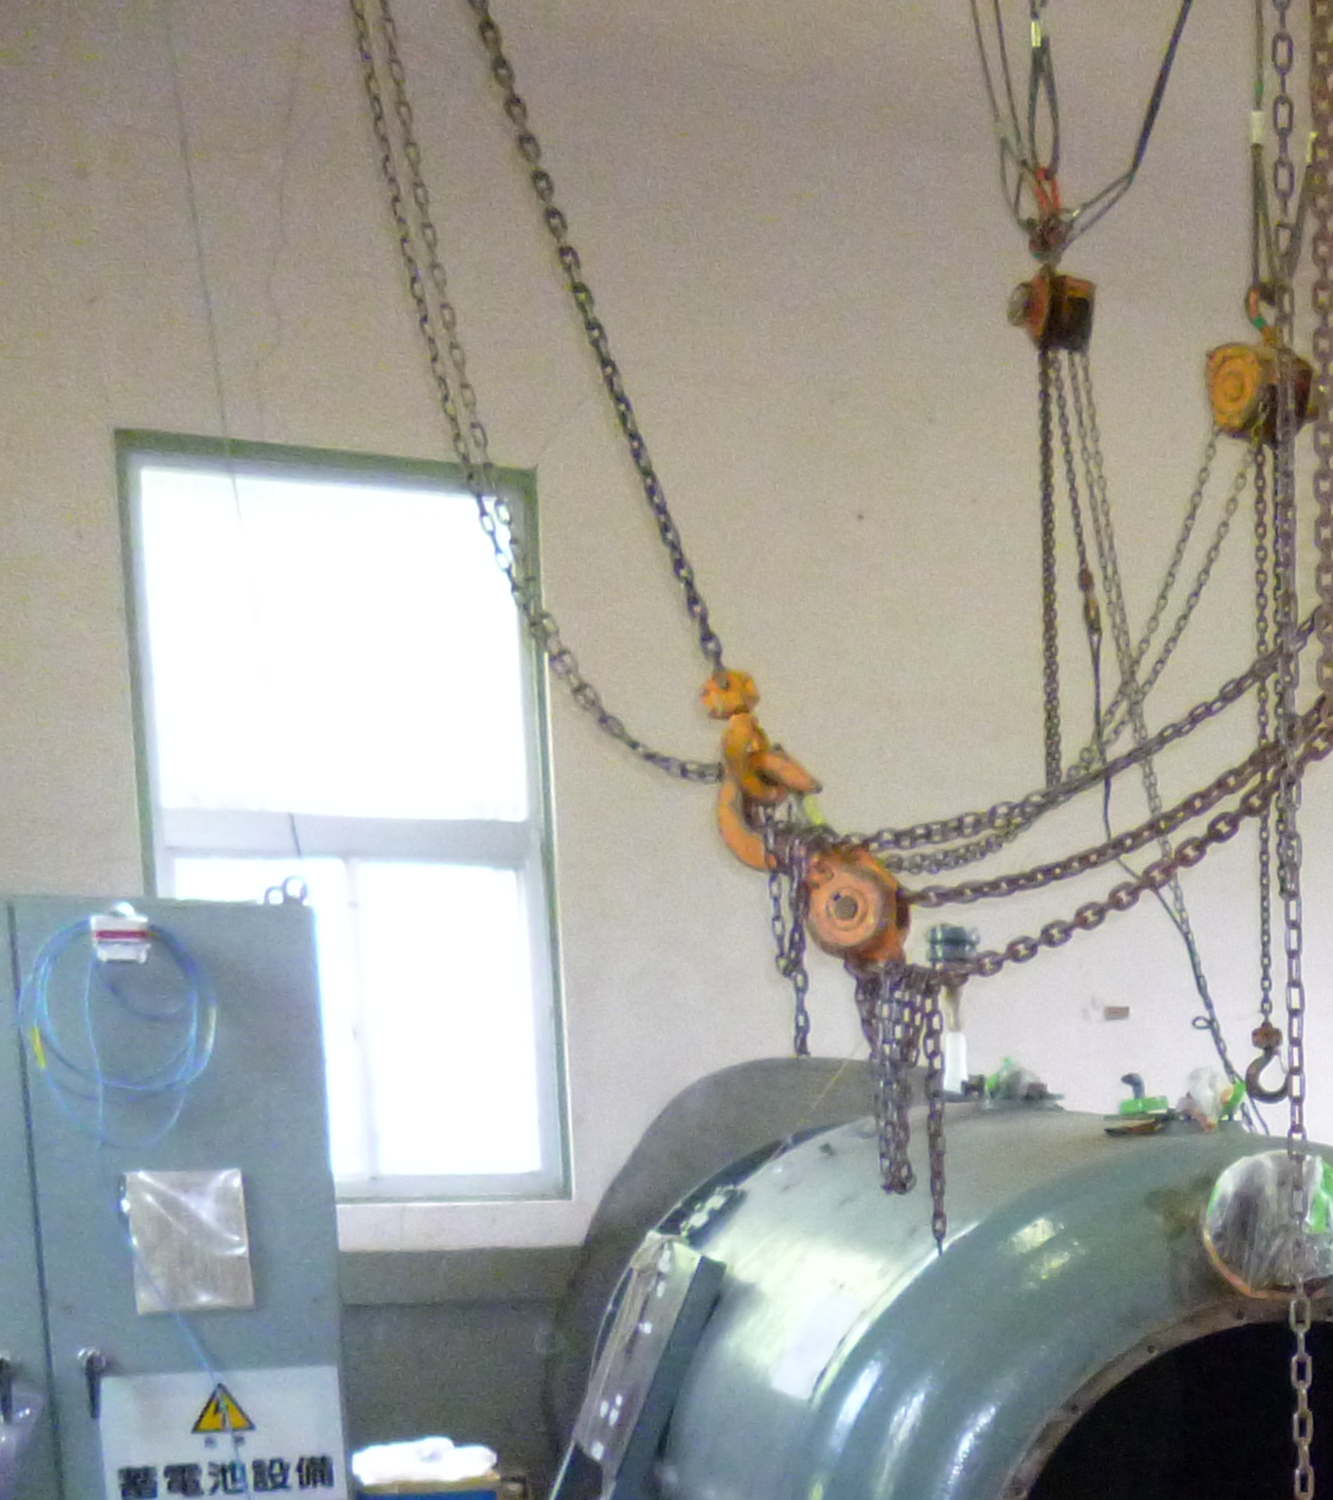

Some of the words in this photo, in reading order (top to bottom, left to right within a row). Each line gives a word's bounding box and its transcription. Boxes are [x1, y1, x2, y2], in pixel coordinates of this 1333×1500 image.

[117, 1453, 336, 1500] 蓄電池設備
